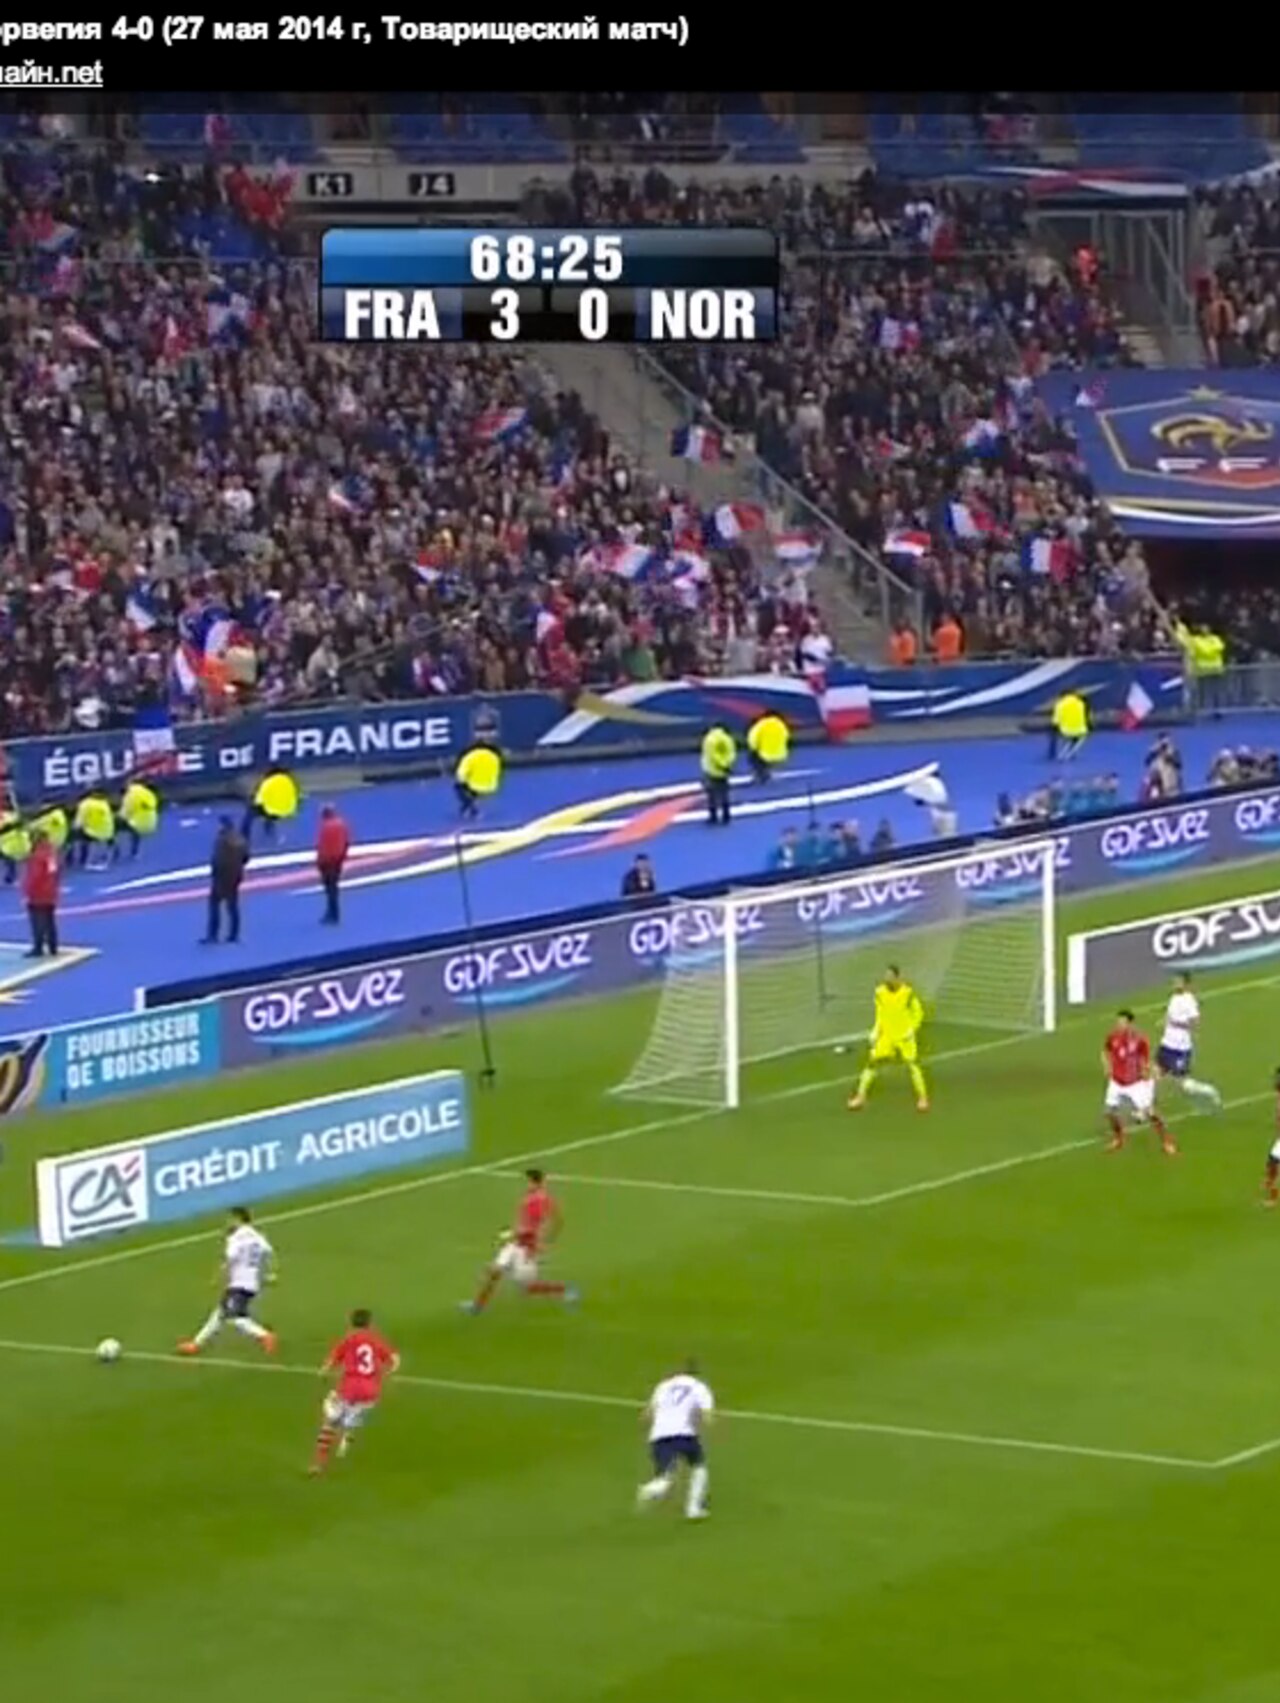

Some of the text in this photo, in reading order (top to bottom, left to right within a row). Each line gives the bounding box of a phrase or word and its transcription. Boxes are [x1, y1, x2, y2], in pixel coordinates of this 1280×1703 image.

[43, 745, 204, 787] ÉQUE
[269, 717, 450, 762] FRANCE
[1236, 795, 1280, 831] GDF
[1101, 821, 1148, 857] GDF
[1153, 910, 1231, 957] GDF
[245, 986, 313, 1032] GDF
[66, 1013, 200, 1061] FOURNISSEUR
[67, 1041, 200, 1089] DE BOISSONS
[154, 1141, 281, 1197] CRÉDIT
[296, 1100, 461, 1163] AGRICOLE
[356, 1343, 375, 1375] 3
